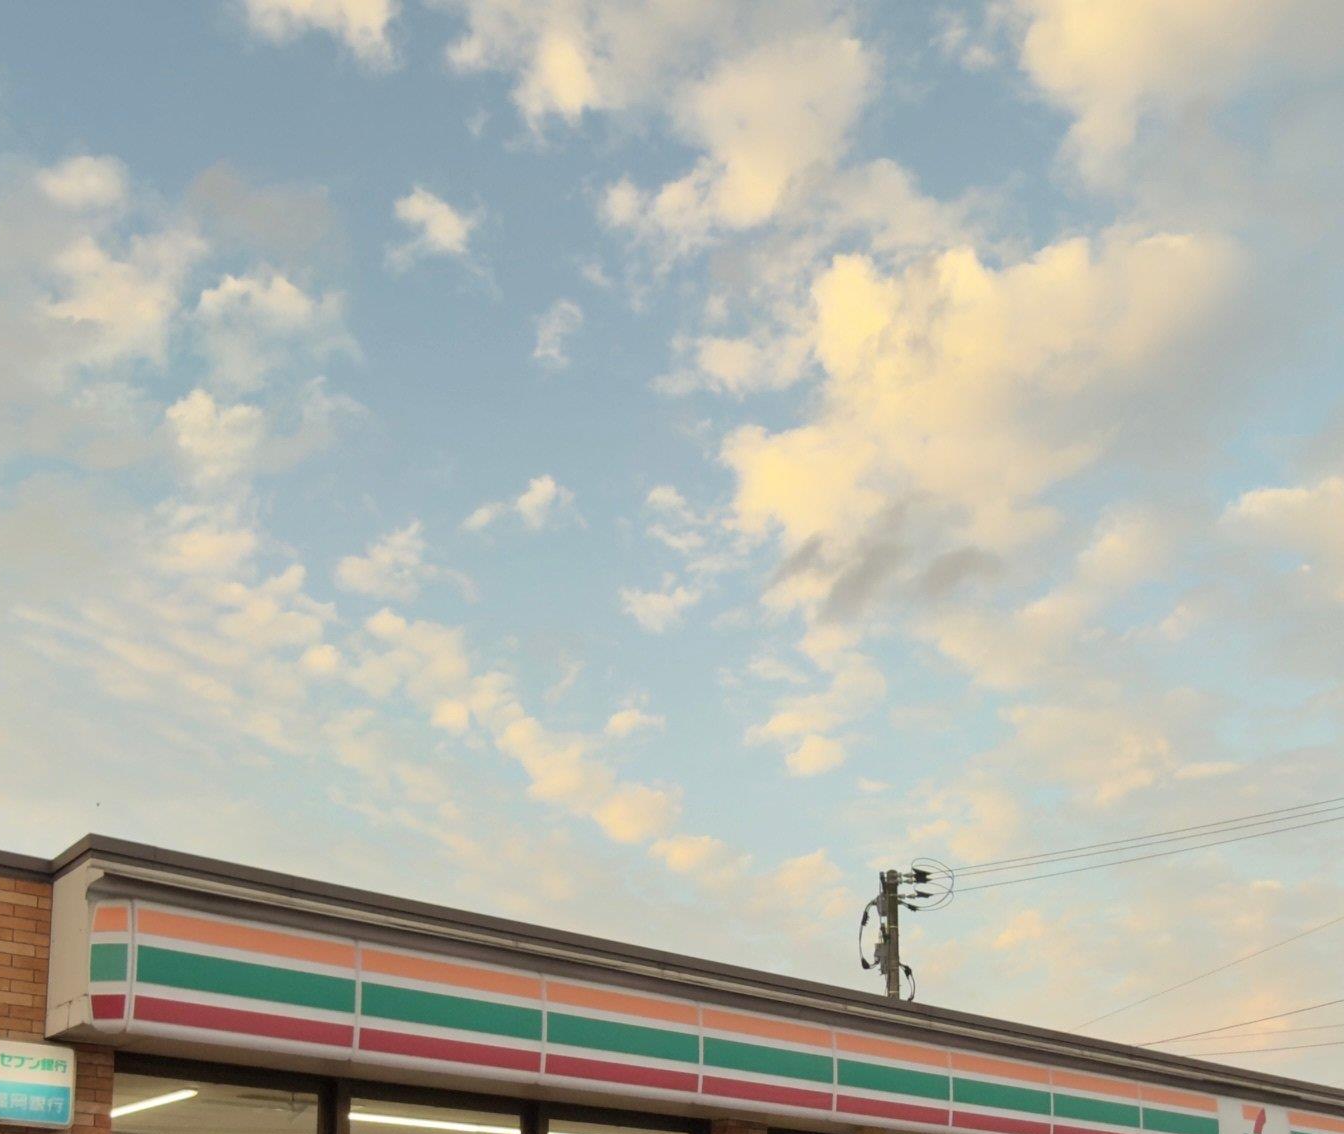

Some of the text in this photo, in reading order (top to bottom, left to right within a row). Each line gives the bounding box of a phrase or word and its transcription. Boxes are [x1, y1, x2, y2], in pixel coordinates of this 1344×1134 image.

[0, 1053, 67, 1073] セブン銀行
